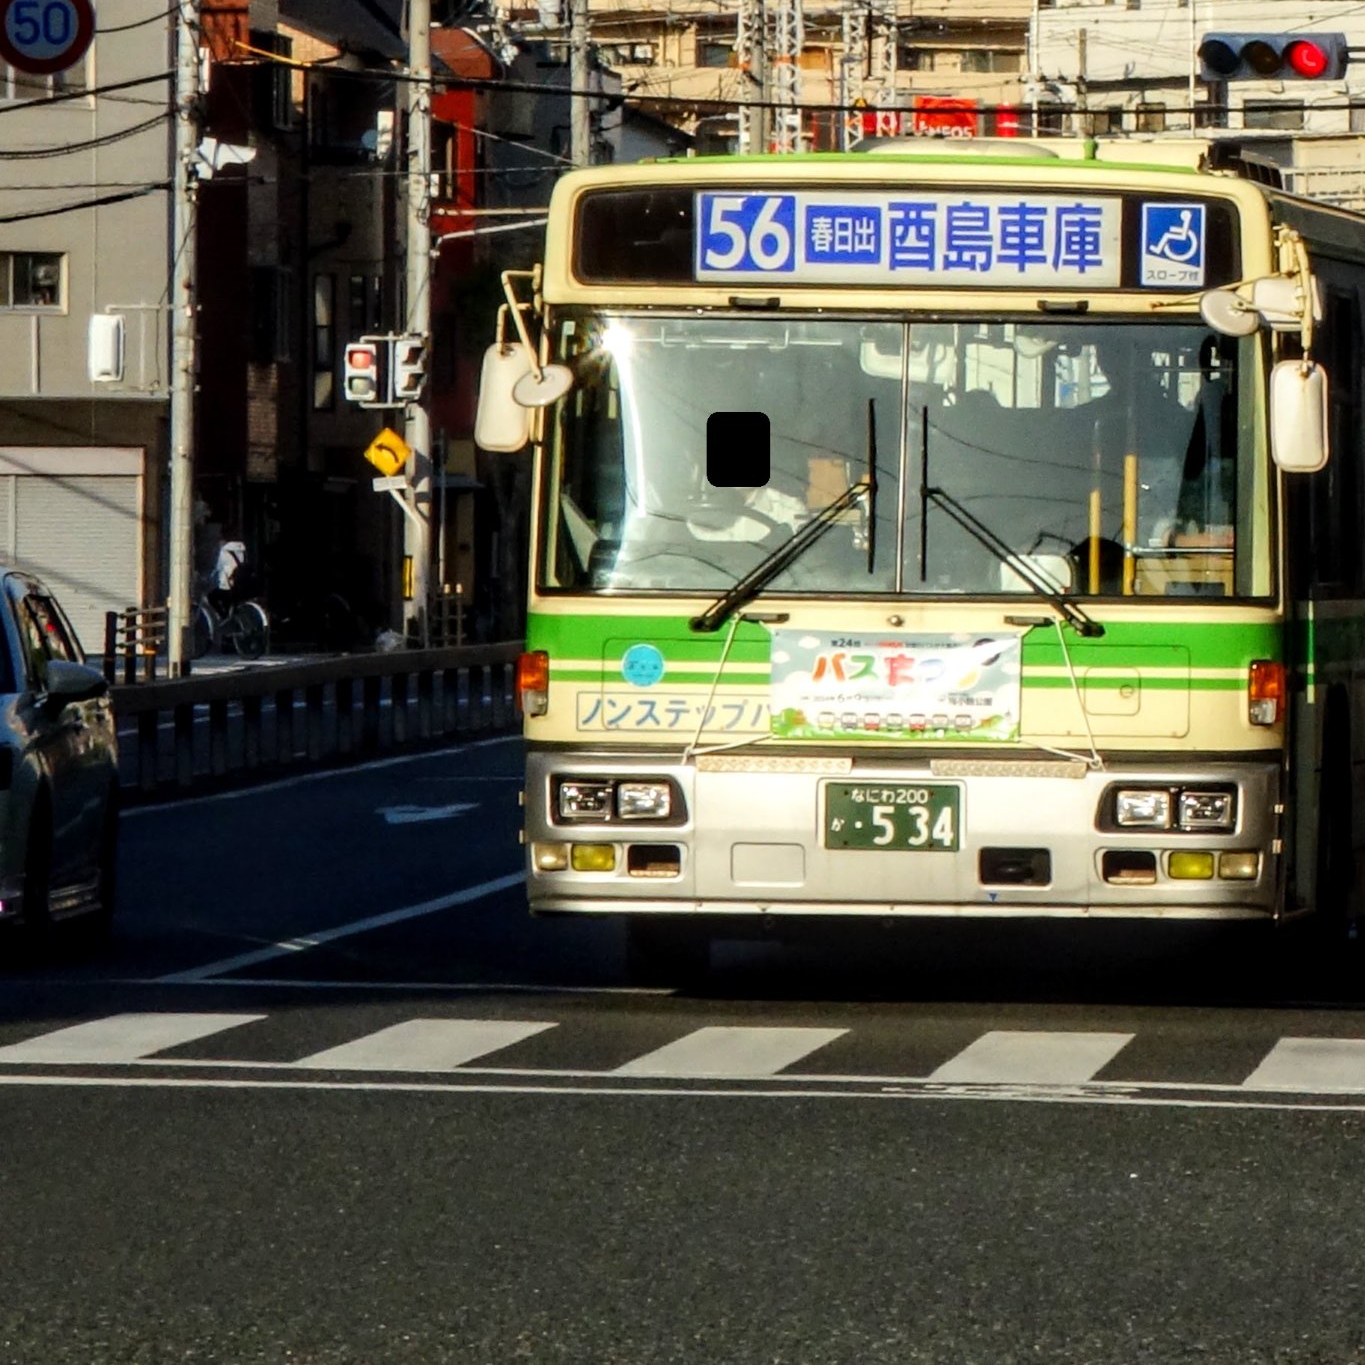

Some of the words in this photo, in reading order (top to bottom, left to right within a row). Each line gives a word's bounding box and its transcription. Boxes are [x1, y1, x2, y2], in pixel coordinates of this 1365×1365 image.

[14, 0, 71, 46] 50
[705, 197, 790, 270] 56
[811, 216, 875, 254] 春日出
[888, 201, 1103, 274] 酉島車庫
[1147, 269, 1200, 282] スロープ付
